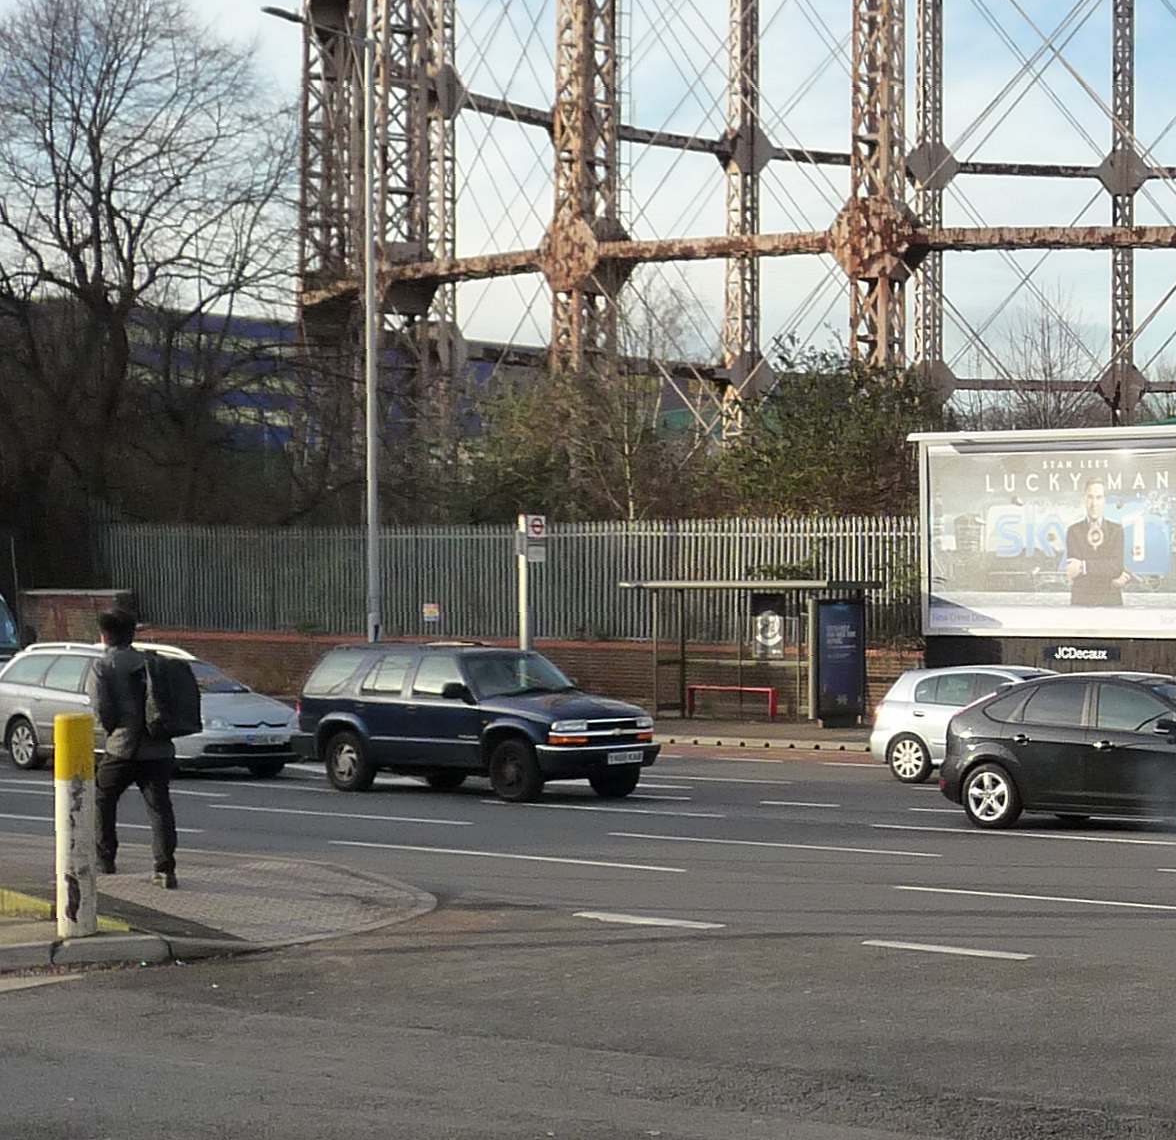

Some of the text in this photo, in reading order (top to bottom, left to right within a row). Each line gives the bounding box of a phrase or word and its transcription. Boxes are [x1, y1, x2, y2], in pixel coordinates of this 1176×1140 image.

[1042, 460, 1073, 469] STAN
[985, 471, 1169, 492] LUCKY MAN
[1054, 646, 1107, 659] JCDecaux
